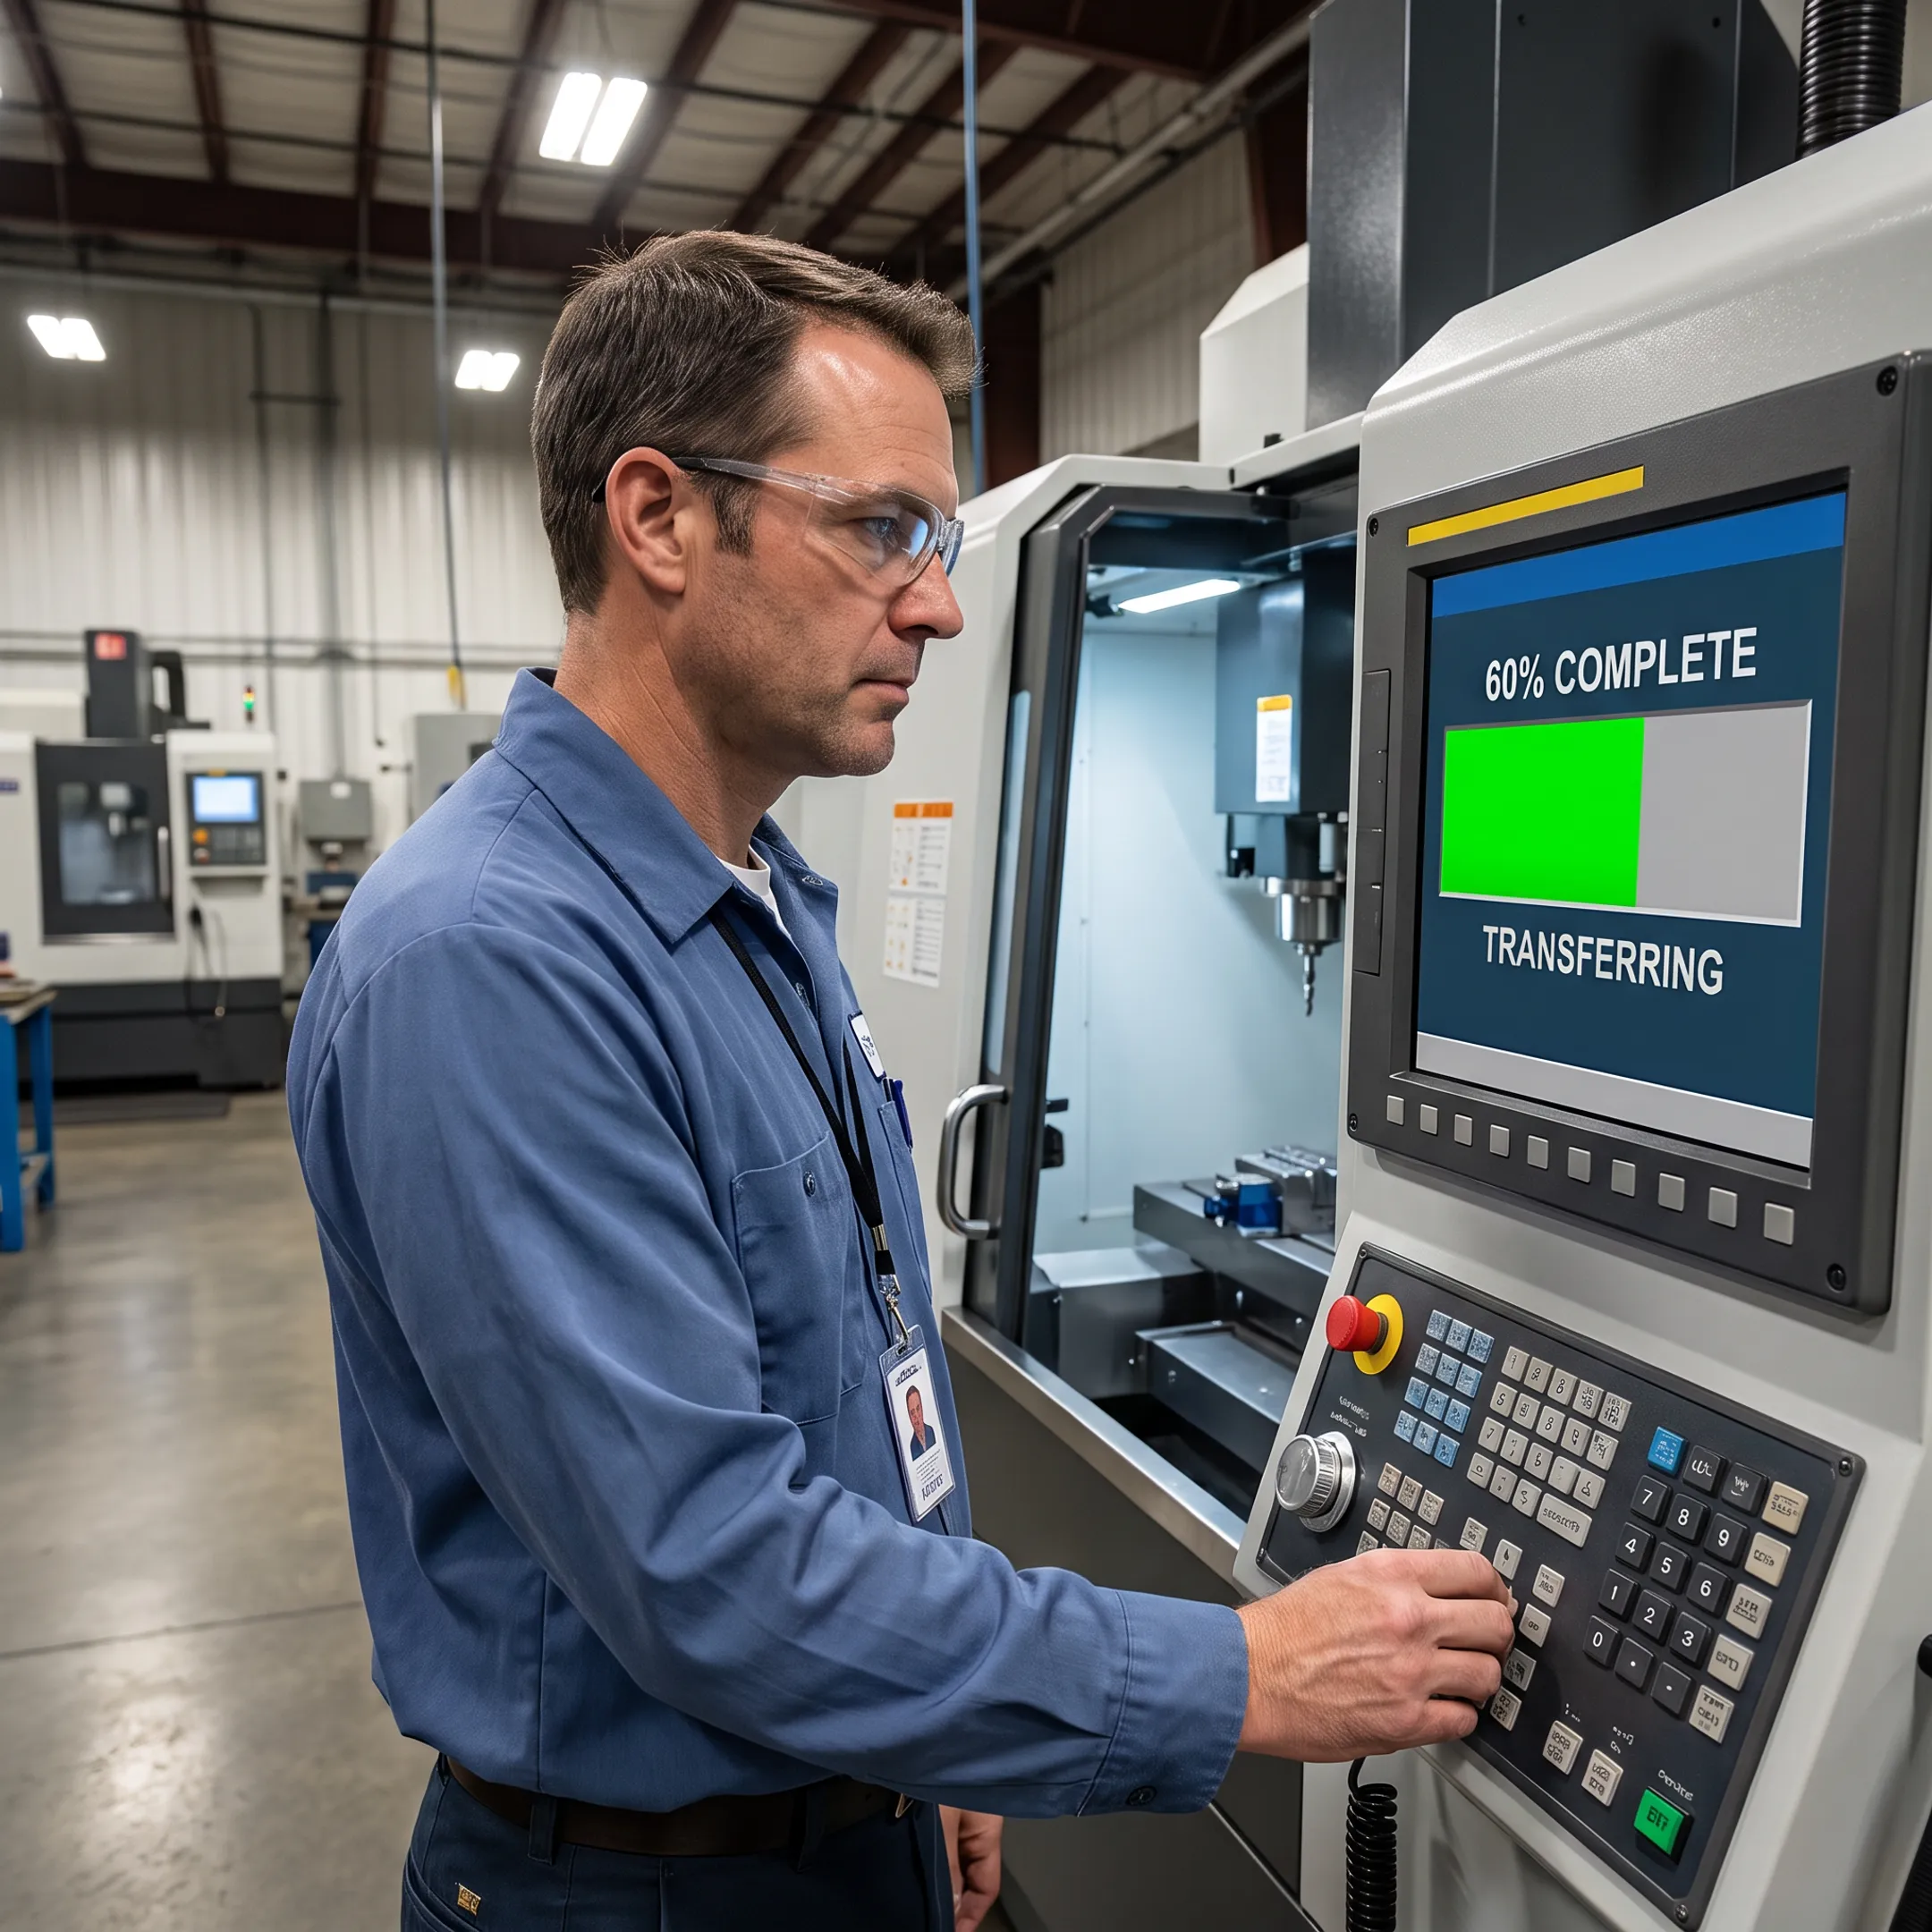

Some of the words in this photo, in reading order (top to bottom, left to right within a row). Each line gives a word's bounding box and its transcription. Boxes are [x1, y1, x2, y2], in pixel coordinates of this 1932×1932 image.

[1486, 653, 1545, 701] 60%
[1555, 626, 1758, 695] COMPLETE
[1482, 925, 1724, 996] TRANSFERRING
[1642, 1488, 1654, 1505] 7
[1677, 1508, 1690, 1526] 8
[1624, 1538, 1637, 1554] 4
[1717, 1529, 1730, 1546] 9
[1660, 1557, 1673, 1574] 5
[1611, 1585, 1618, 1600] 1
[1699, 1580, 1712, 1597] 6
[1643, 1607, 1656, 1624] 2
[1592, 1631, 1603, 1648] 0
[1682, 1630, 1694, 1647] 3
